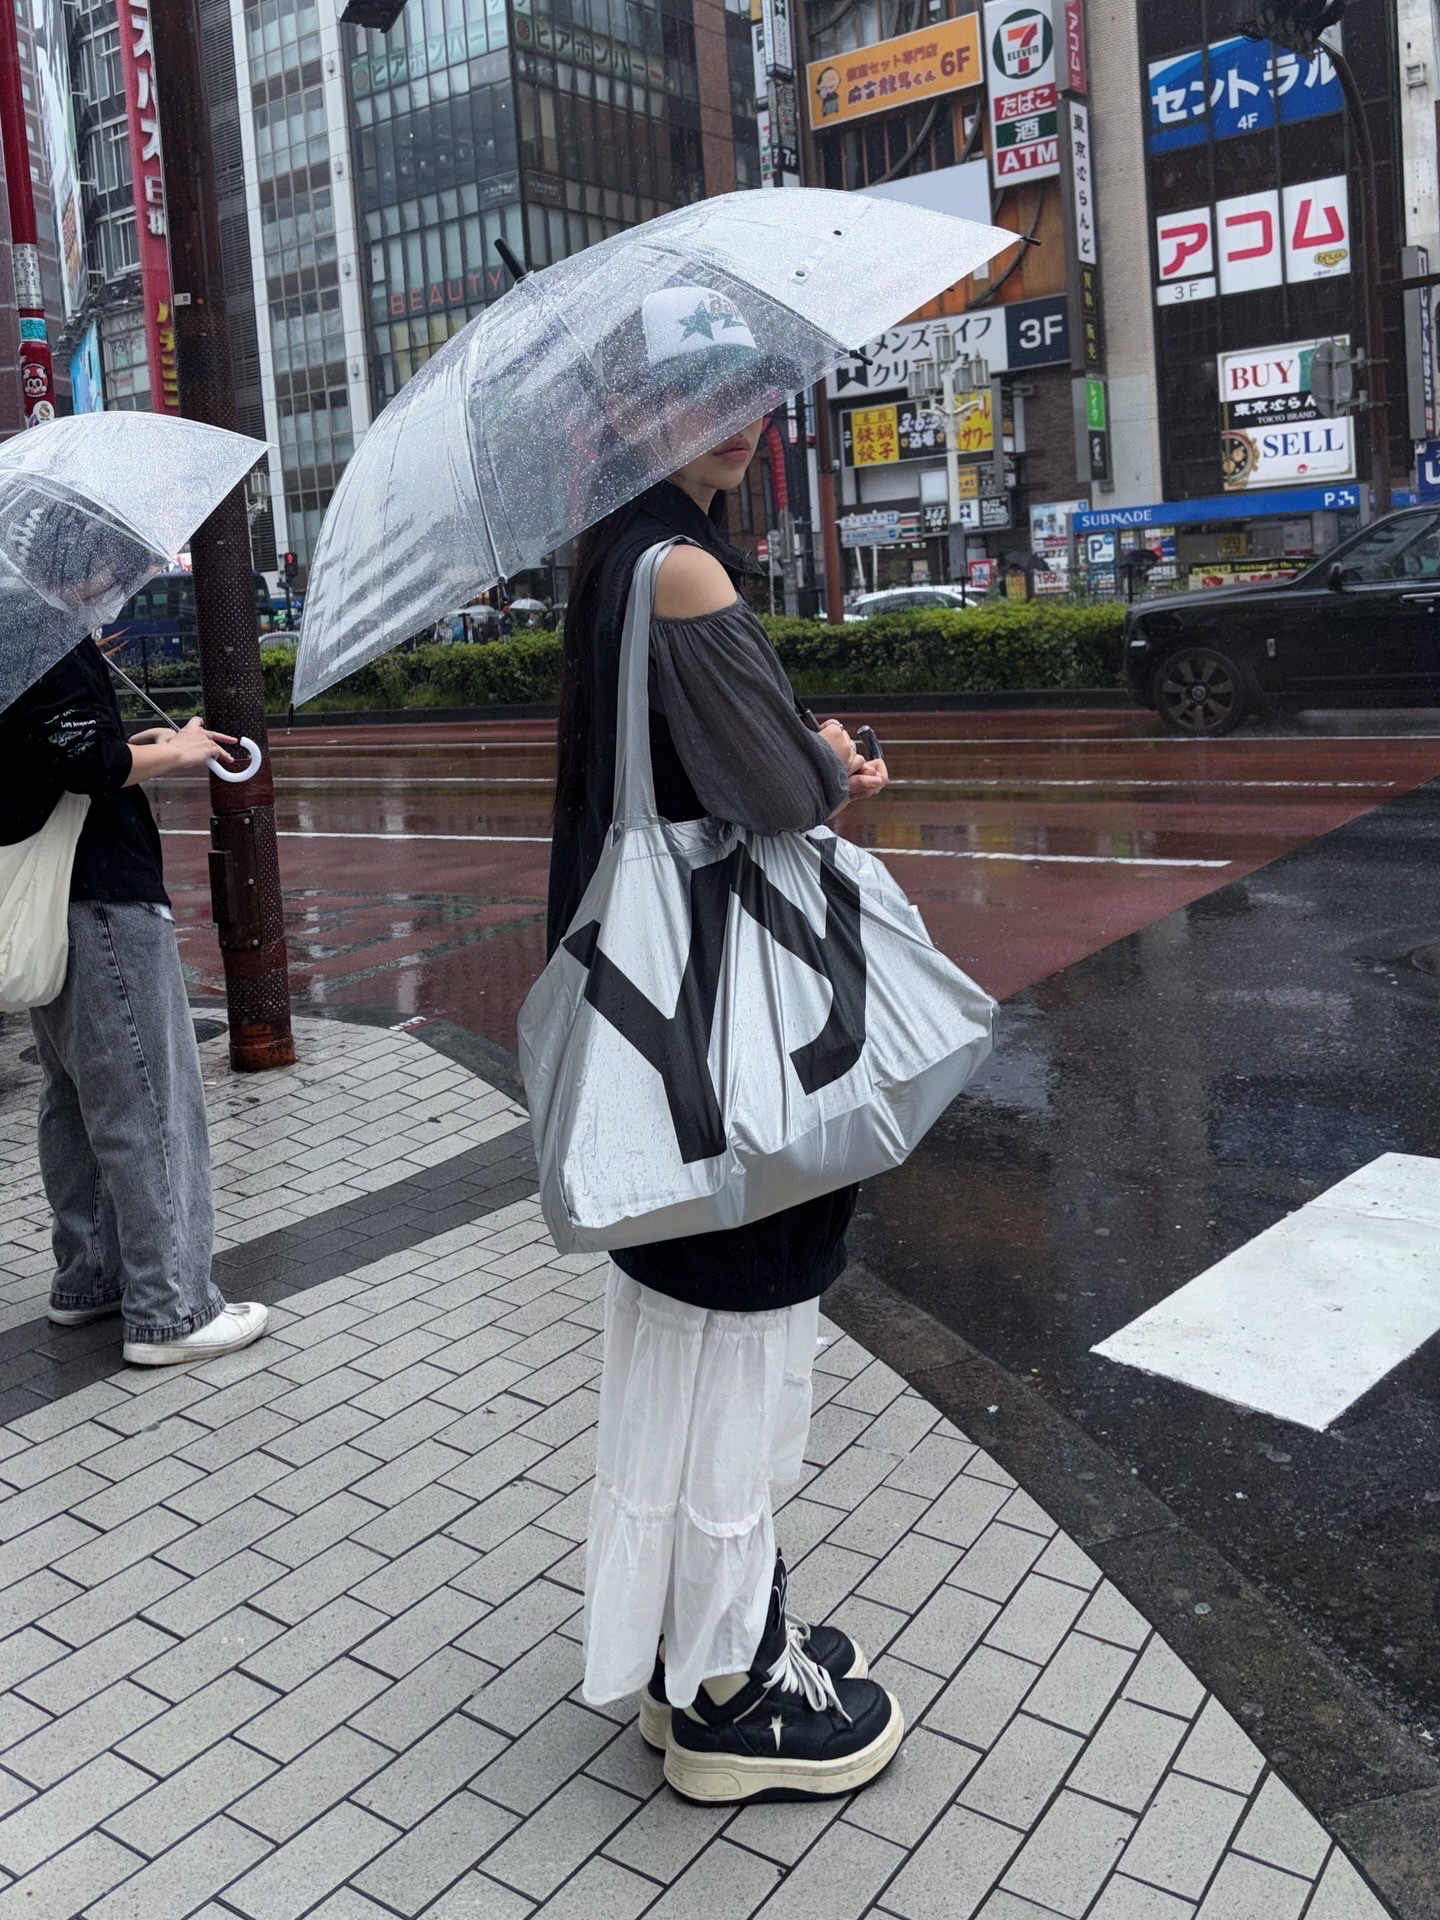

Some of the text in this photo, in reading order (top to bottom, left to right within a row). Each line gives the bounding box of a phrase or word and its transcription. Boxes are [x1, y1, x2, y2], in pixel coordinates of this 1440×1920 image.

[1008, 45, 1039, 61] ELEVEN
[1068, 12, 1080, 72] アコム
[941, 46, 970, 77] 6F
[1152, 47, 1337, 123] セントラル
[1001, 88, 1052, 118] たばこ
[1015, 117, 1039, 142] 酒
[1237, 112, 1258, 130] 4F
[1003, 141, 1058, 173] ATM
[1161, 199, 1345, 276] アコム
[390, 268, 504, 315] BEAUTY
[1174, 282, 1199, 300] 3F
[1019, 314, 1063, 349] 3F
[1231, 360, 1294, 390] BUY
[1257, 411, 1316, 424] TOKYO BRAND
[1263, 428, 1344, 458] SELL
[1324, 492, 1336, 506] P
[1082, 510, 1152, 527] SUBNADE
[1090, 540, 1103, 560] P
